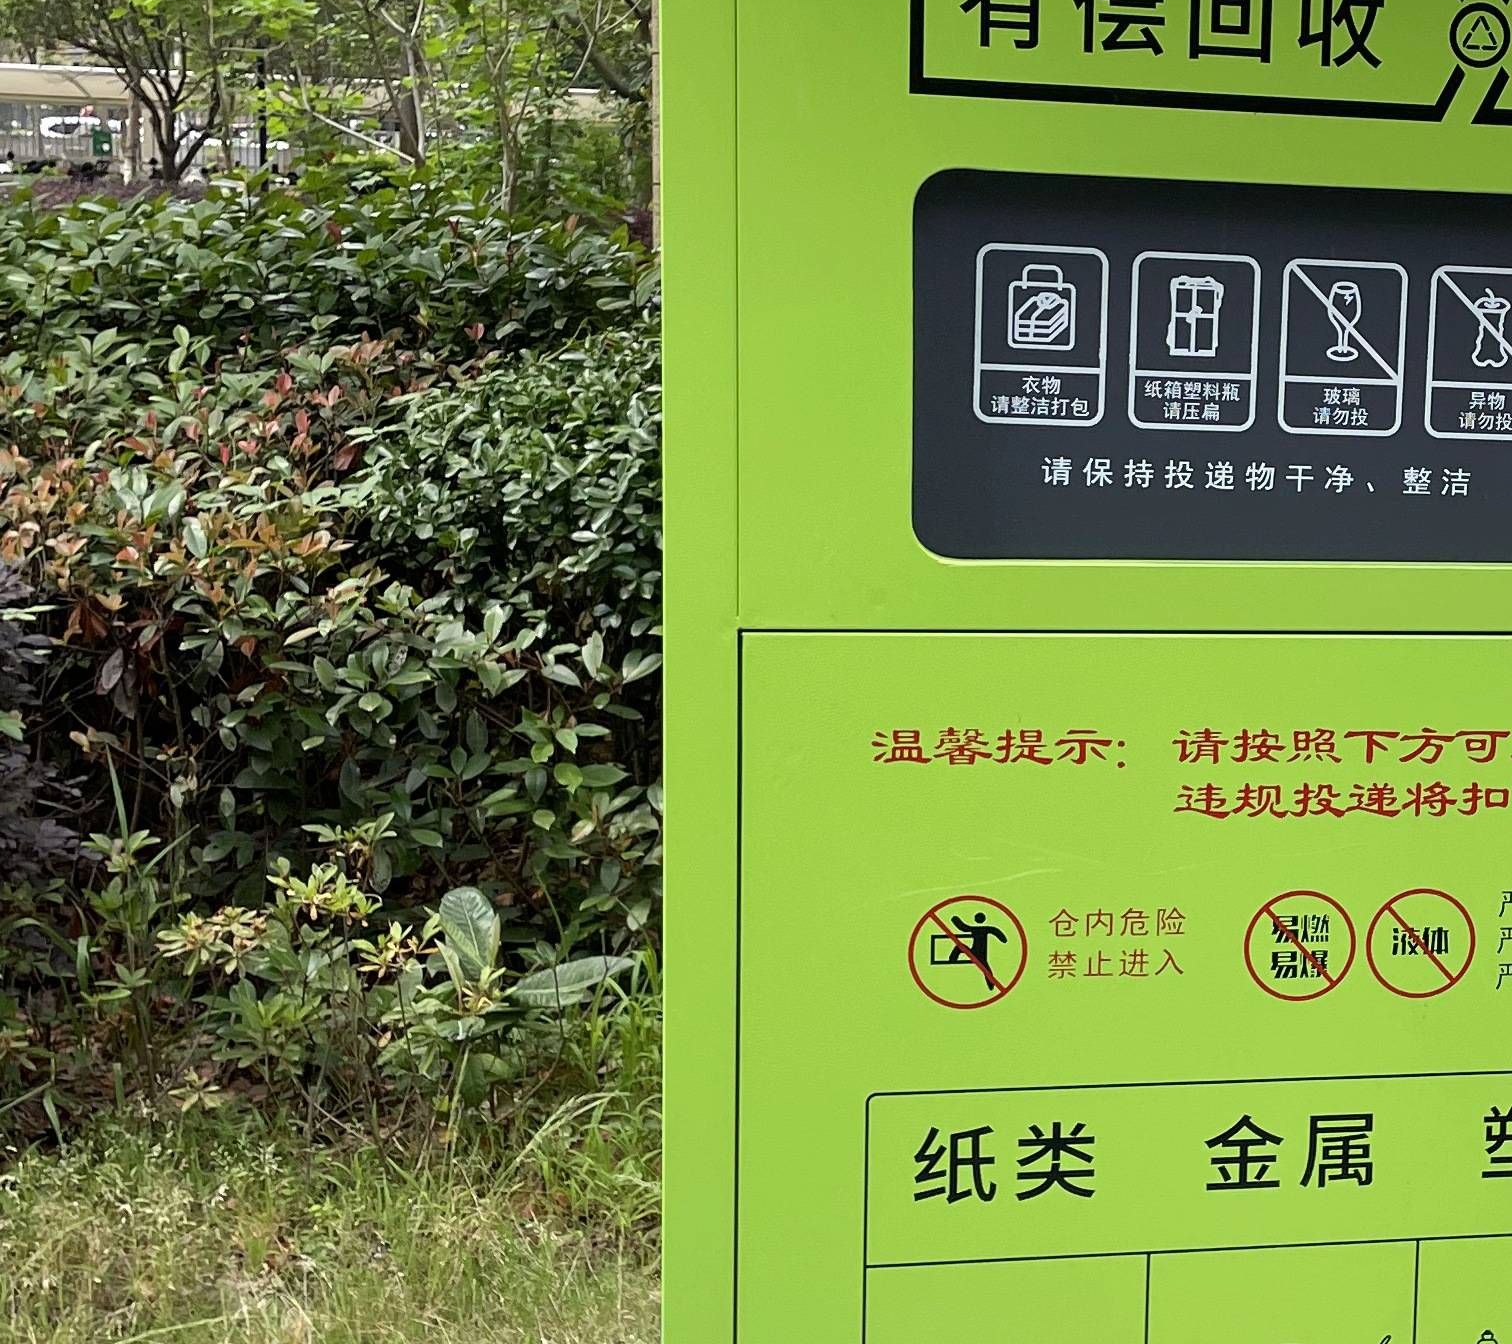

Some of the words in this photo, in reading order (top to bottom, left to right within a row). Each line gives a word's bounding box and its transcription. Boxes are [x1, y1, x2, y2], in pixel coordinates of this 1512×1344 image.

[1021, 375, 1062, 396] 衣物
[1144, 380, 1241, 404] 纸箱塑料瓶
[1322, 387, 1362, 407] 玻璃
[990, 393, 1090, 418] 请整洁打包
[1162, 399, 1221, 423] 请压扁
[1468, 390, 1507, 411] 异物
[1312, 405, 1370, 428] 请勿投
[1041, 456, 1472, 498] 请保持投递物干净、整洁
[1048, 907, 1187, 939] 仓内危险
[1271, 914, 1331, 944] 易燃
[1391, 926, 1450, 957] 液体
[1047, 948, 1185, 980] 禁止进入
[1271, 950, 1329, 980] 易爆
[913, 1121, 1096, 1204] 纸类
[1204, 1113, 1375, 1191] 金属
